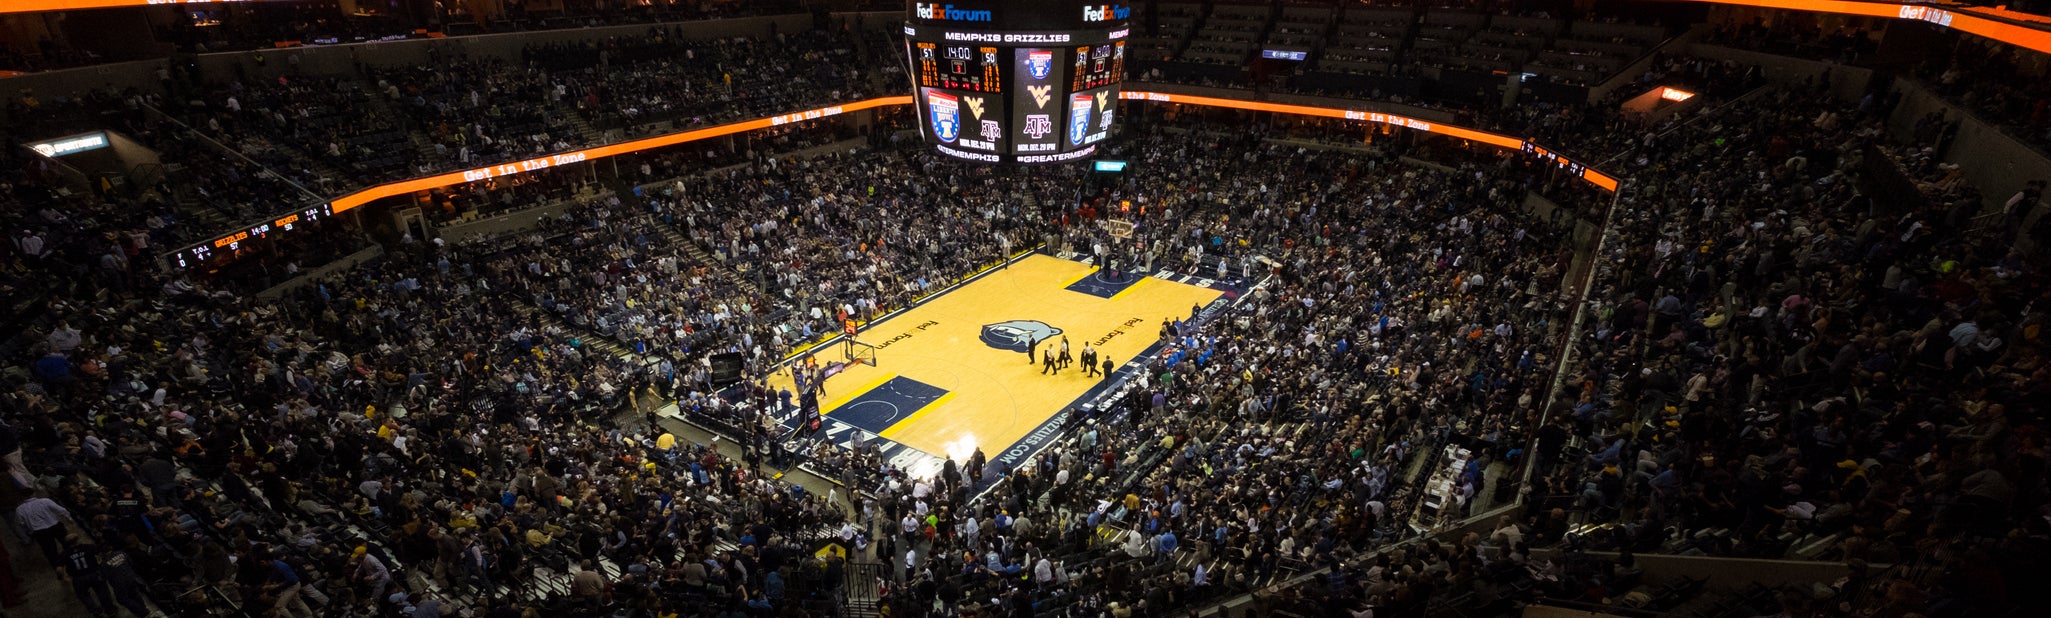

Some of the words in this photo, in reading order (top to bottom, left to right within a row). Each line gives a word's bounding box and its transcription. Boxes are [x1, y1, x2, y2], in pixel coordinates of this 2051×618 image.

[916, 3, 992, 21] FedExForum
[1899, 5, 1926, 20] Get
[945, 32, 1001, 42] MEMPHIS
[1004, 34, 1070, 43] GRIZZLIES
[923, 48, 933, 58] 57
[947, 47, 970, 60] 14:00
[985, 53, 995, 63] 50
[1148, 92, 1170, 101] Zone
[772, 115, 789, 126] Get
[792, 113, 803, 123] in
[805, 109, 820, 120] the
[824, 106, 843, 116] Zone
[1345, 110, 1365, 120] Get
[1370, 113, 1384, 122] in
[1388, 115, 1405, 126] the
[1407, 118, 1430, 131] Zone
[463, 167, 493, 182] Get
[499, 164, 518, 176] in
[522, 159, 549, 171] the
[553, 152, 586, 167] Zone
[251, 224, 270, 236] 14:00
[284, 223, 293, 232] 50
[214, 231, 249, 248] GRIZZLIES
[230, 241, 239, 250] 57
